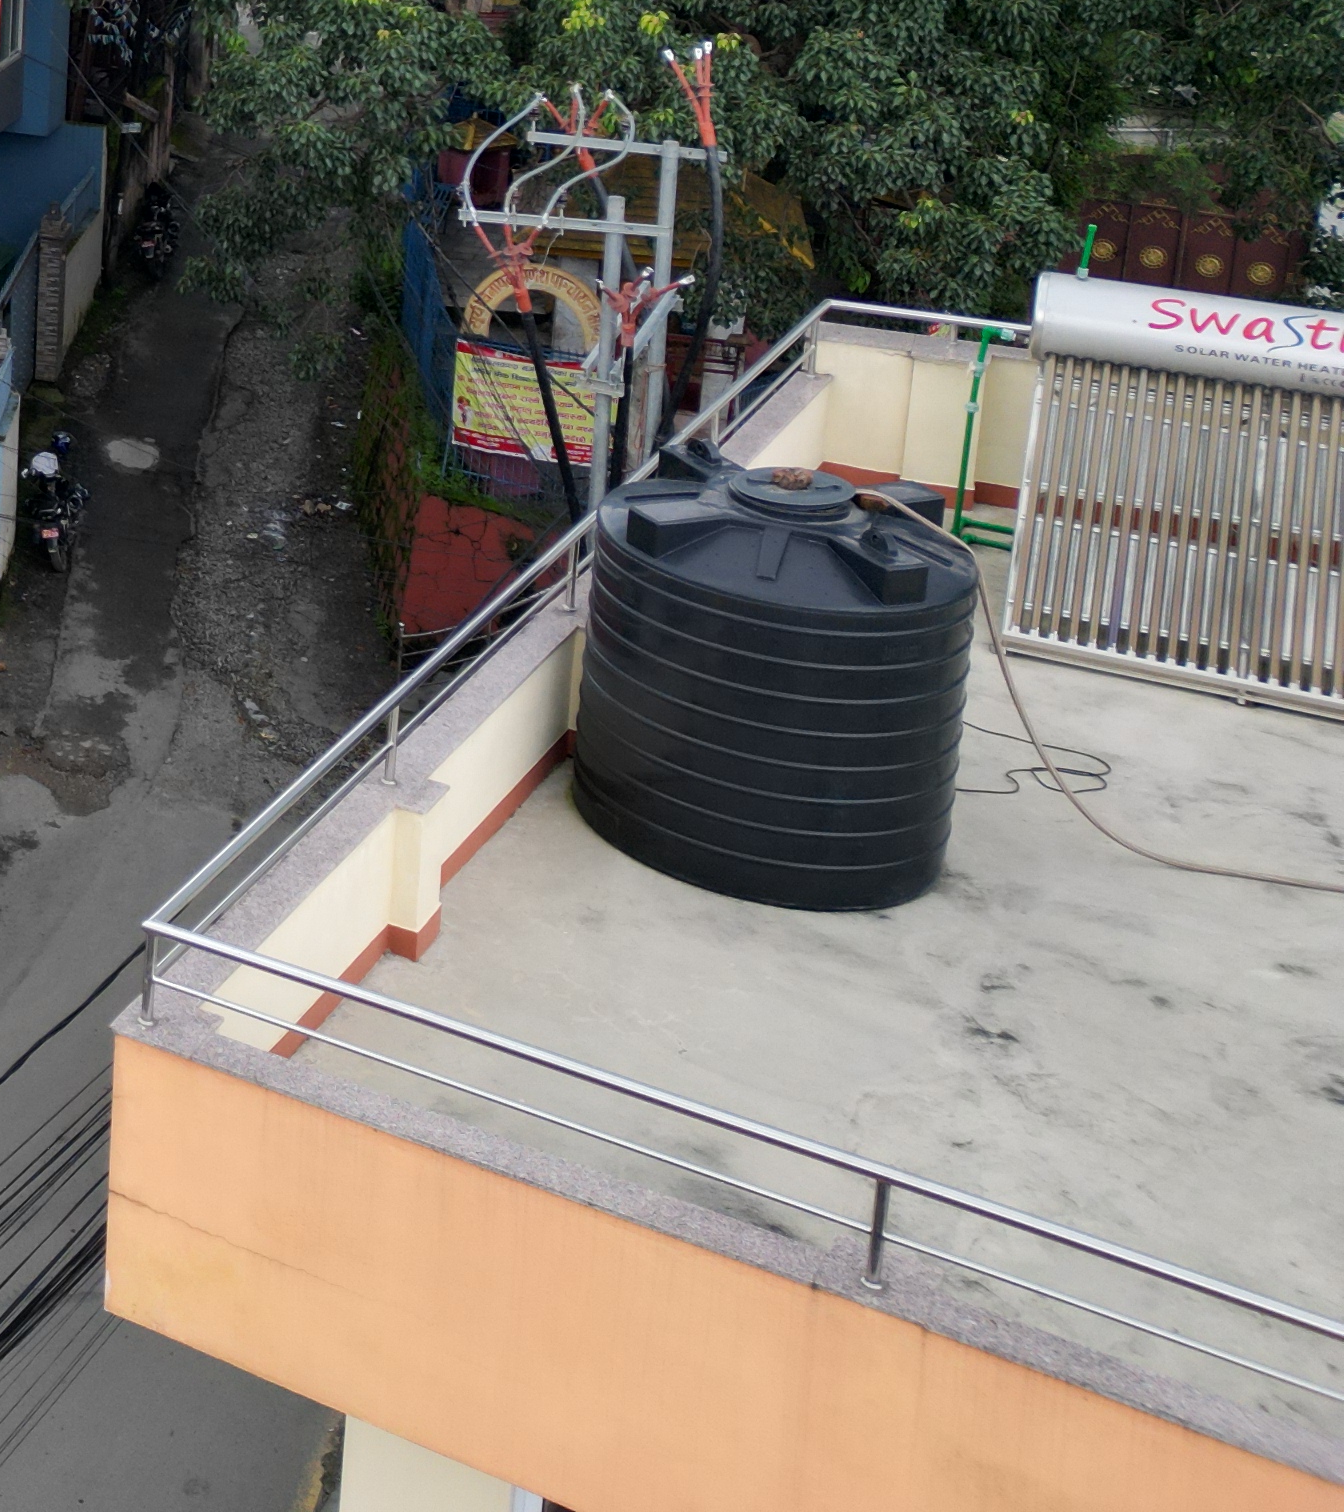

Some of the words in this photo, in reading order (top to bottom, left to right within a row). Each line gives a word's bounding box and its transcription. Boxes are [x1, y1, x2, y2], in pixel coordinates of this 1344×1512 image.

[1148, 298, 1344, 354] Swast
[1174, 344, 1230, 360] SOLAR
[1234, 352, 1292, 368] WATER
